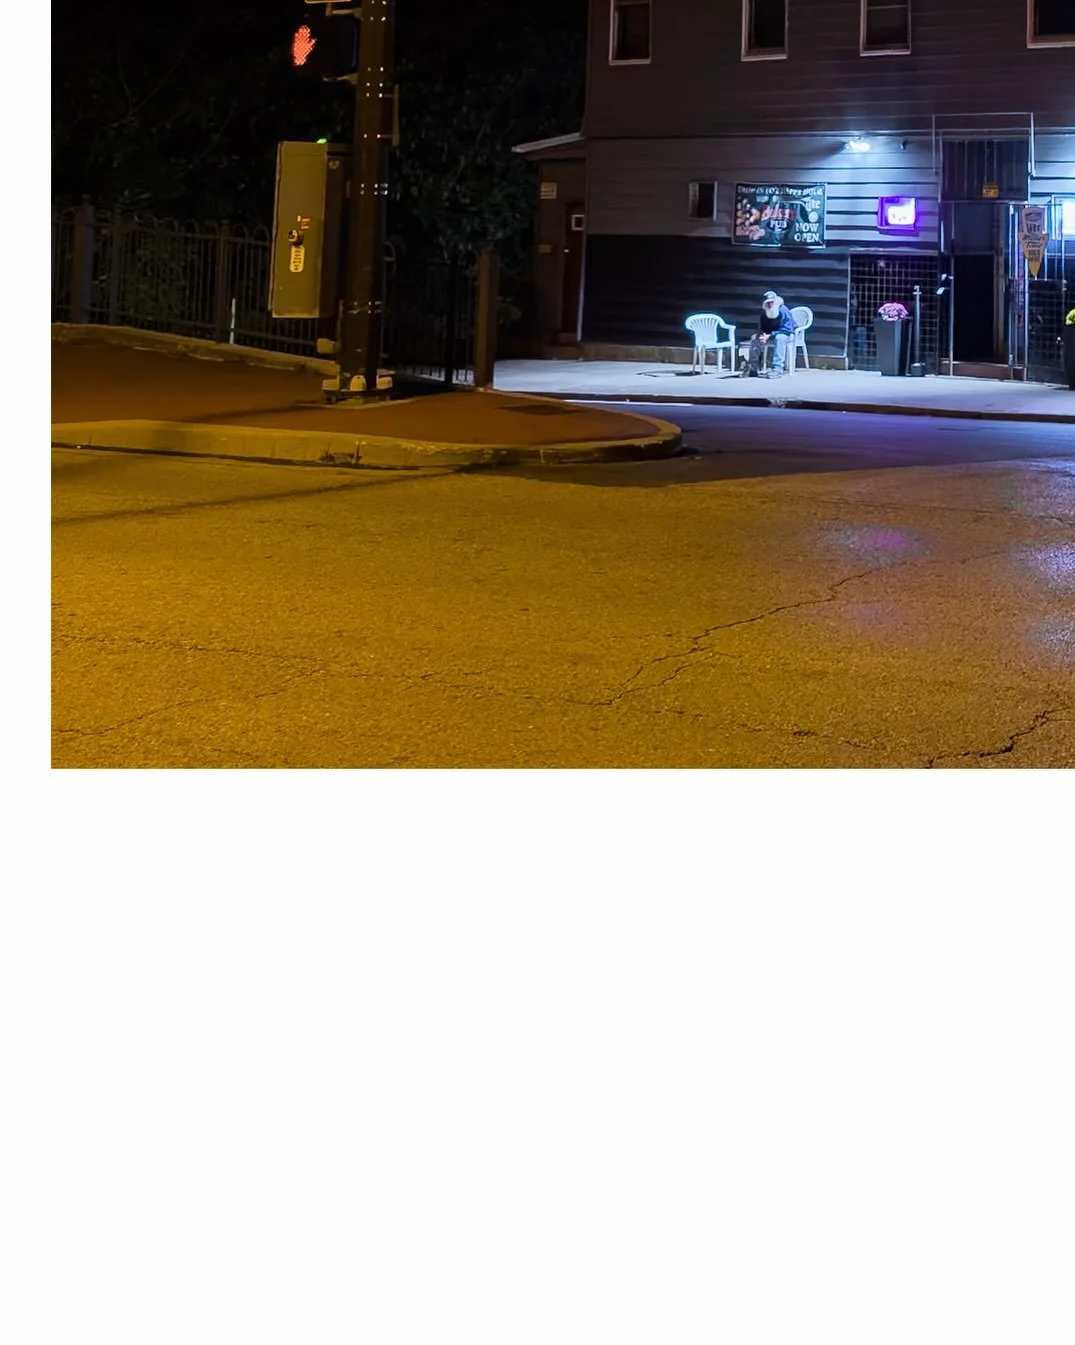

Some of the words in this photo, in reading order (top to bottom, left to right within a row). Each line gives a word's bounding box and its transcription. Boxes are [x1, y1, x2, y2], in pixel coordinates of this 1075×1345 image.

[770, 220, 787, 229] PUB
[795, 223, 819, 233] NOW
[794, 233, 819, 243] OPEN
